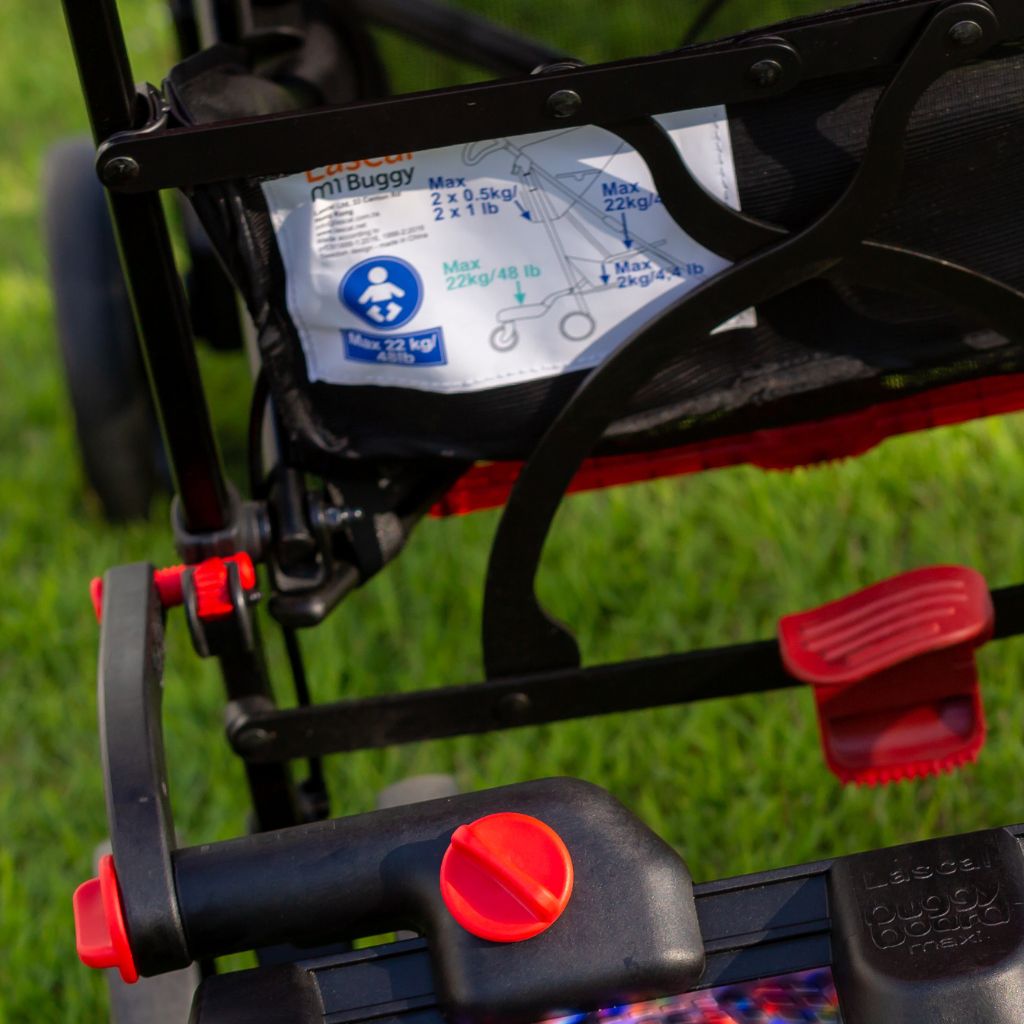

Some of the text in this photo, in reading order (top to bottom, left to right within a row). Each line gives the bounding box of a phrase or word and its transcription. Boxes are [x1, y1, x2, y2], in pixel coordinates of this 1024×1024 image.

[346, 166, 415, 192] Buggy
[428, 176, 466, 190] Max
[431, 185, 518, 206] 2 x 0.5kg/
[602, 182, 640, 197] Max
[433, 202, 500, 221] 2 x 1 lb
[442, 259, 480, 276] Max
[523, 264, 541, 278] lb
[614, 261, 651, 274] Max
[686, 262, 704, 275] lb
[384, 338, 406, 351] 22
